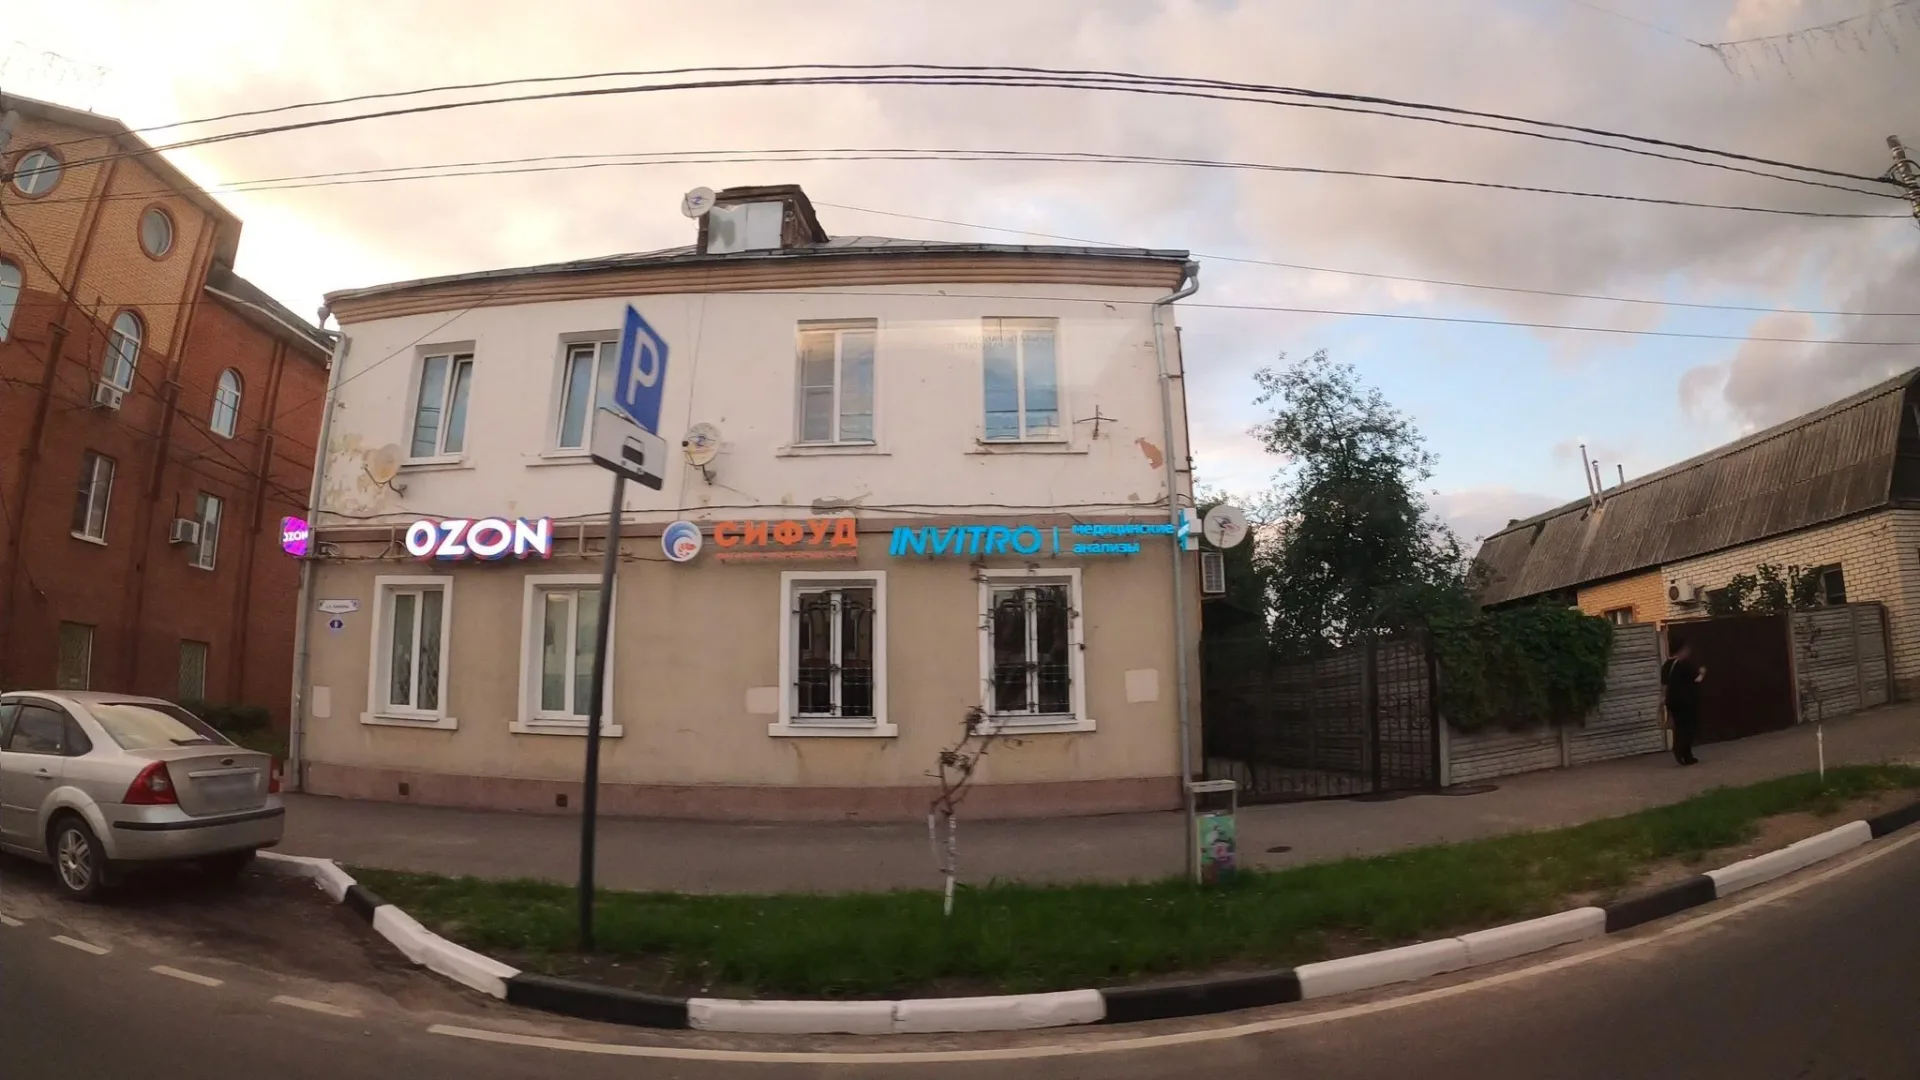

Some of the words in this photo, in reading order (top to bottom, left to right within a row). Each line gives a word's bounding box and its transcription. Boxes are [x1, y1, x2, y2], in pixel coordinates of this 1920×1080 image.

[626, 327, 659, 405] P
[405, 518, 550, 558] OZON
[714, 518, 858, 548] СИФУД
[888, 524, 1041, 556] INVITRO
[1072, 524, 1174, 536] медицинские
[1073, 543, 1140, 553] анализы
